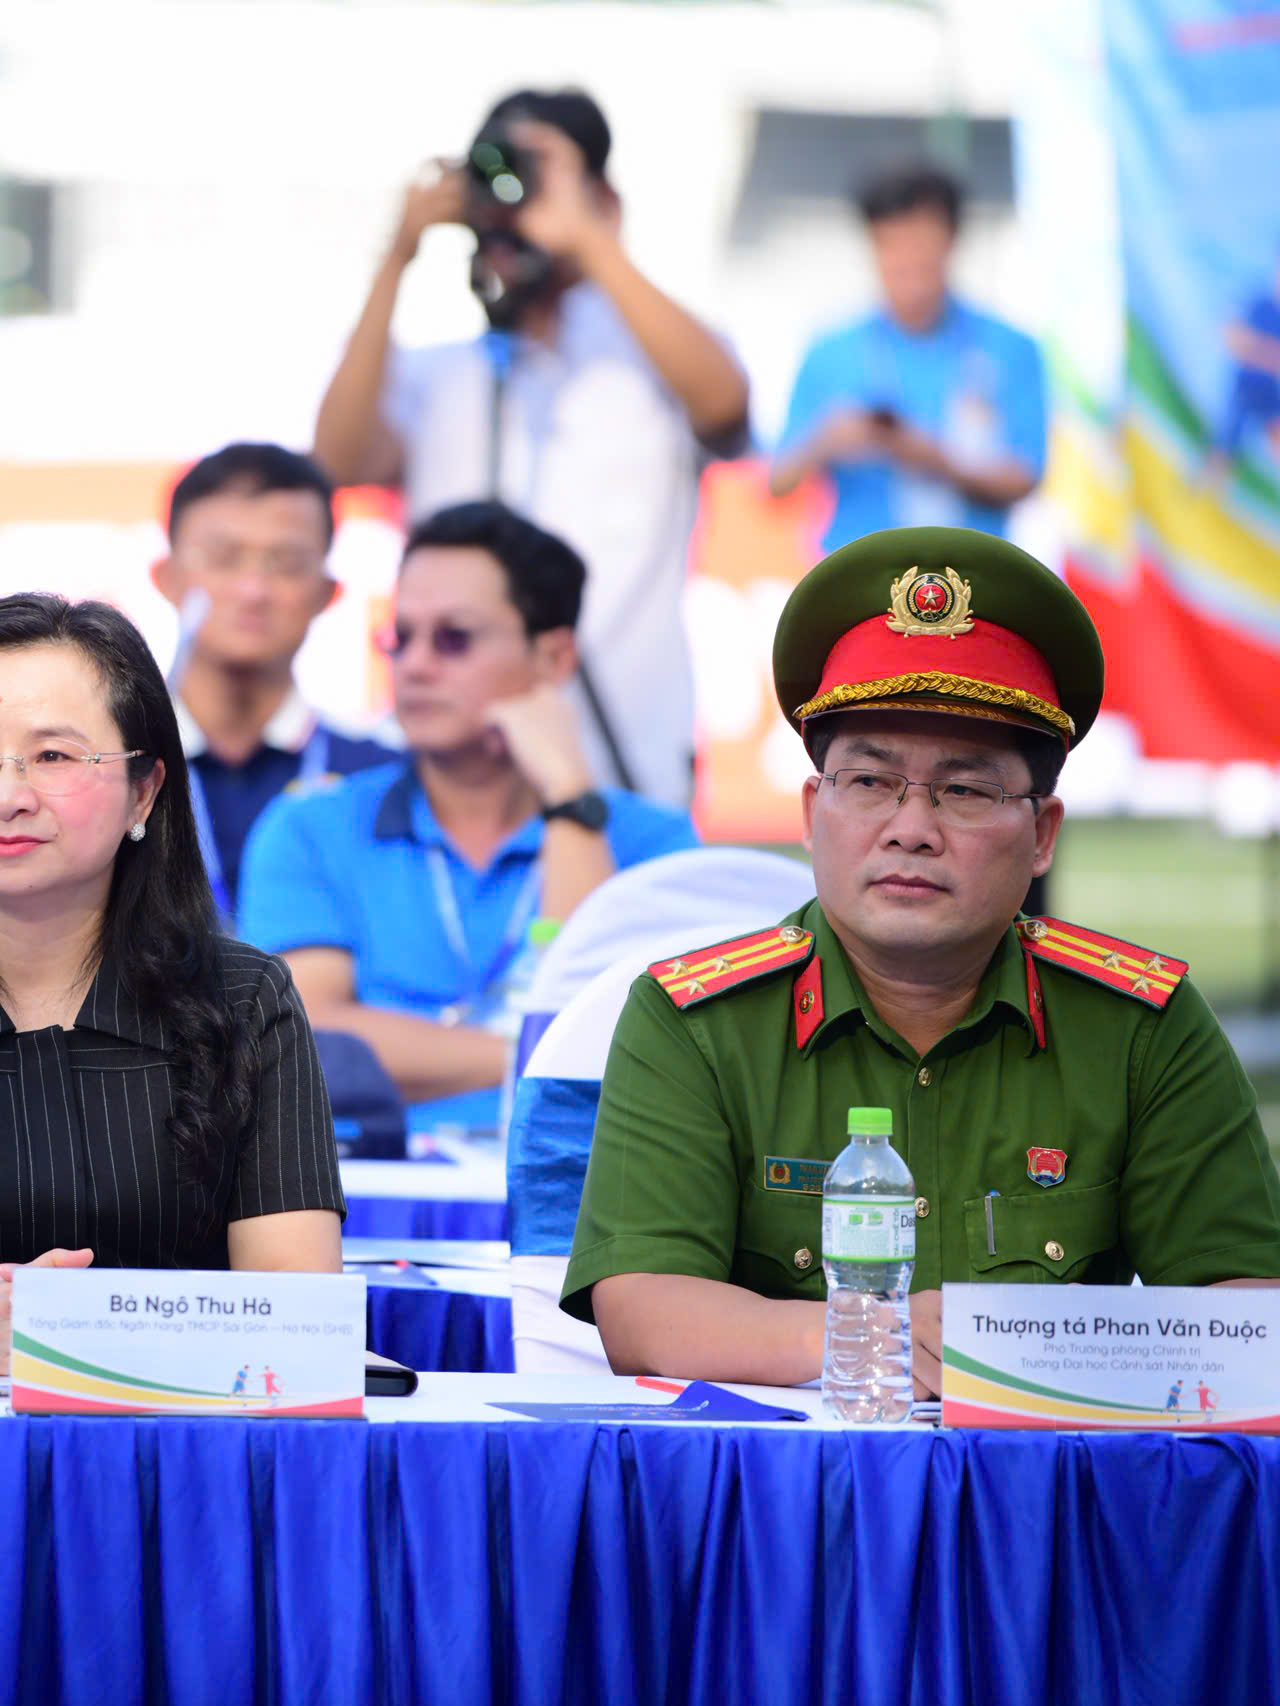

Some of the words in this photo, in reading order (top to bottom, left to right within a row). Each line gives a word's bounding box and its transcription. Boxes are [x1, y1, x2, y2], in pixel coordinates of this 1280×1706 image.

[110, 1294, 138, 1312] Bà
[145, 1295, 189, 1318] Ngô
[195, 1296, 235, 1314] Thu
[242, 1296, 272, 1315] Hà
[972, 1315, 1056, 1340] Thượng
[1062, 1317, 1087, 1335] tá
[1093, 1317, 1150, 1336] Phan
[1157, 1318, 1201, 1337] Văn
[1208, 1319, 1267, 1343] Đuộc
[1043, 1342, 1066, 1354] Phó
[1112, 1344, 1150, 1358] phòng
[1152, 1343, 1186, 1357] Chính
[1189, 1346, 1201, 1359] trị
[1063, 1358, 1083, 1371] Đại
[1087, 1359, 1109, 1372] học
[1145, 1360, 1164, 1371] sát
[1167, 1360, 1199, 1372] Nhân
[1201, 1360, 1224, 1373] dân
